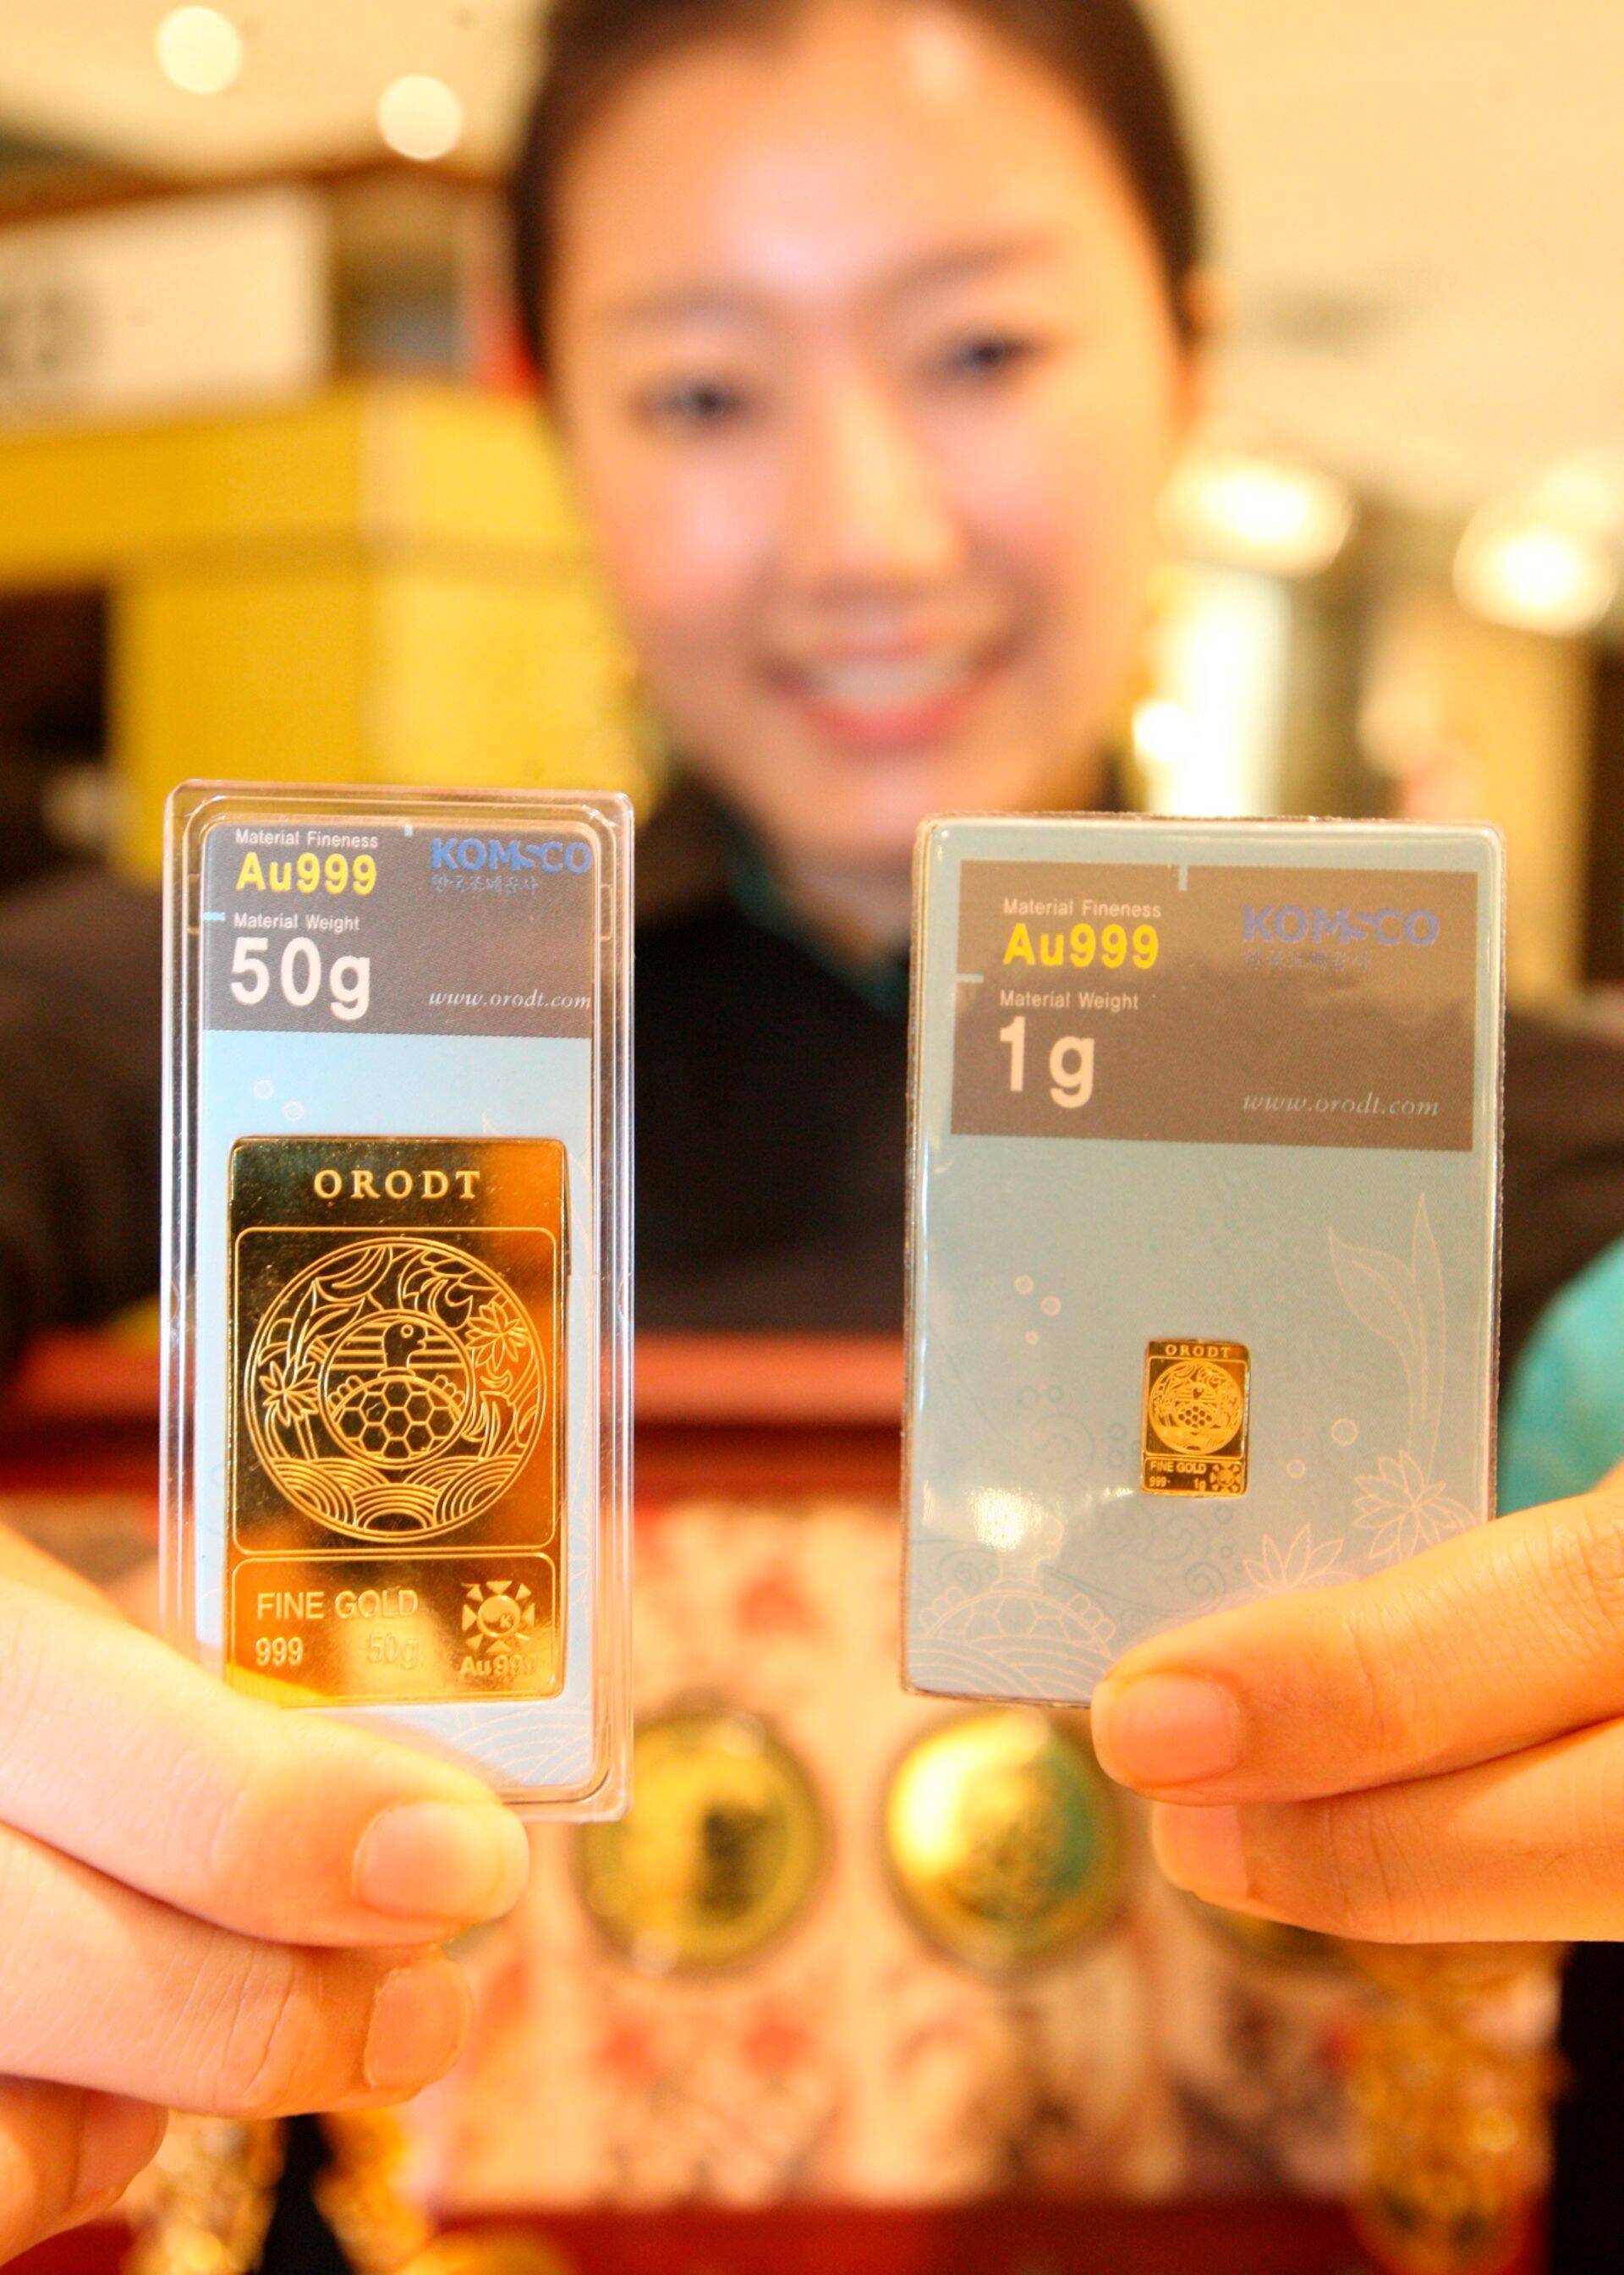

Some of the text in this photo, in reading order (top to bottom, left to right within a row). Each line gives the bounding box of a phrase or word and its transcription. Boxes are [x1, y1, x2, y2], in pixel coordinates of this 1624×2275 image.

[235, 827, 379, 849] Material Fineness
[431, 838, 592, 875] KOMSCO
[235, 851, 377, 896] Au999
[233, 912, 360, 932] Material Weight
[1003, 897, 1162, 919] Material Fineness
[1002, 921, 1160, 970] Au999
[230, 936, 371, 1022] 50g
[428, 988, 591, 1010] www.orodt.com
[1000, 989, 1139, 1012] Material Weight
[999, 1015, 1095, 1109] 1g
[1241, 1091, 1440, 1118] www.orodt.com
[314, 1169, 480, 1200] ORODT
[1165, 1344, 1232, 1359] ORODT
[1149, 1460, 1207, 1474] FINE GOLD
[256, 1590, 420, 1620] FINE GOLD
[255, 1636, 304, 1667] 999
[367, 1632, 420, 1669] 50g
